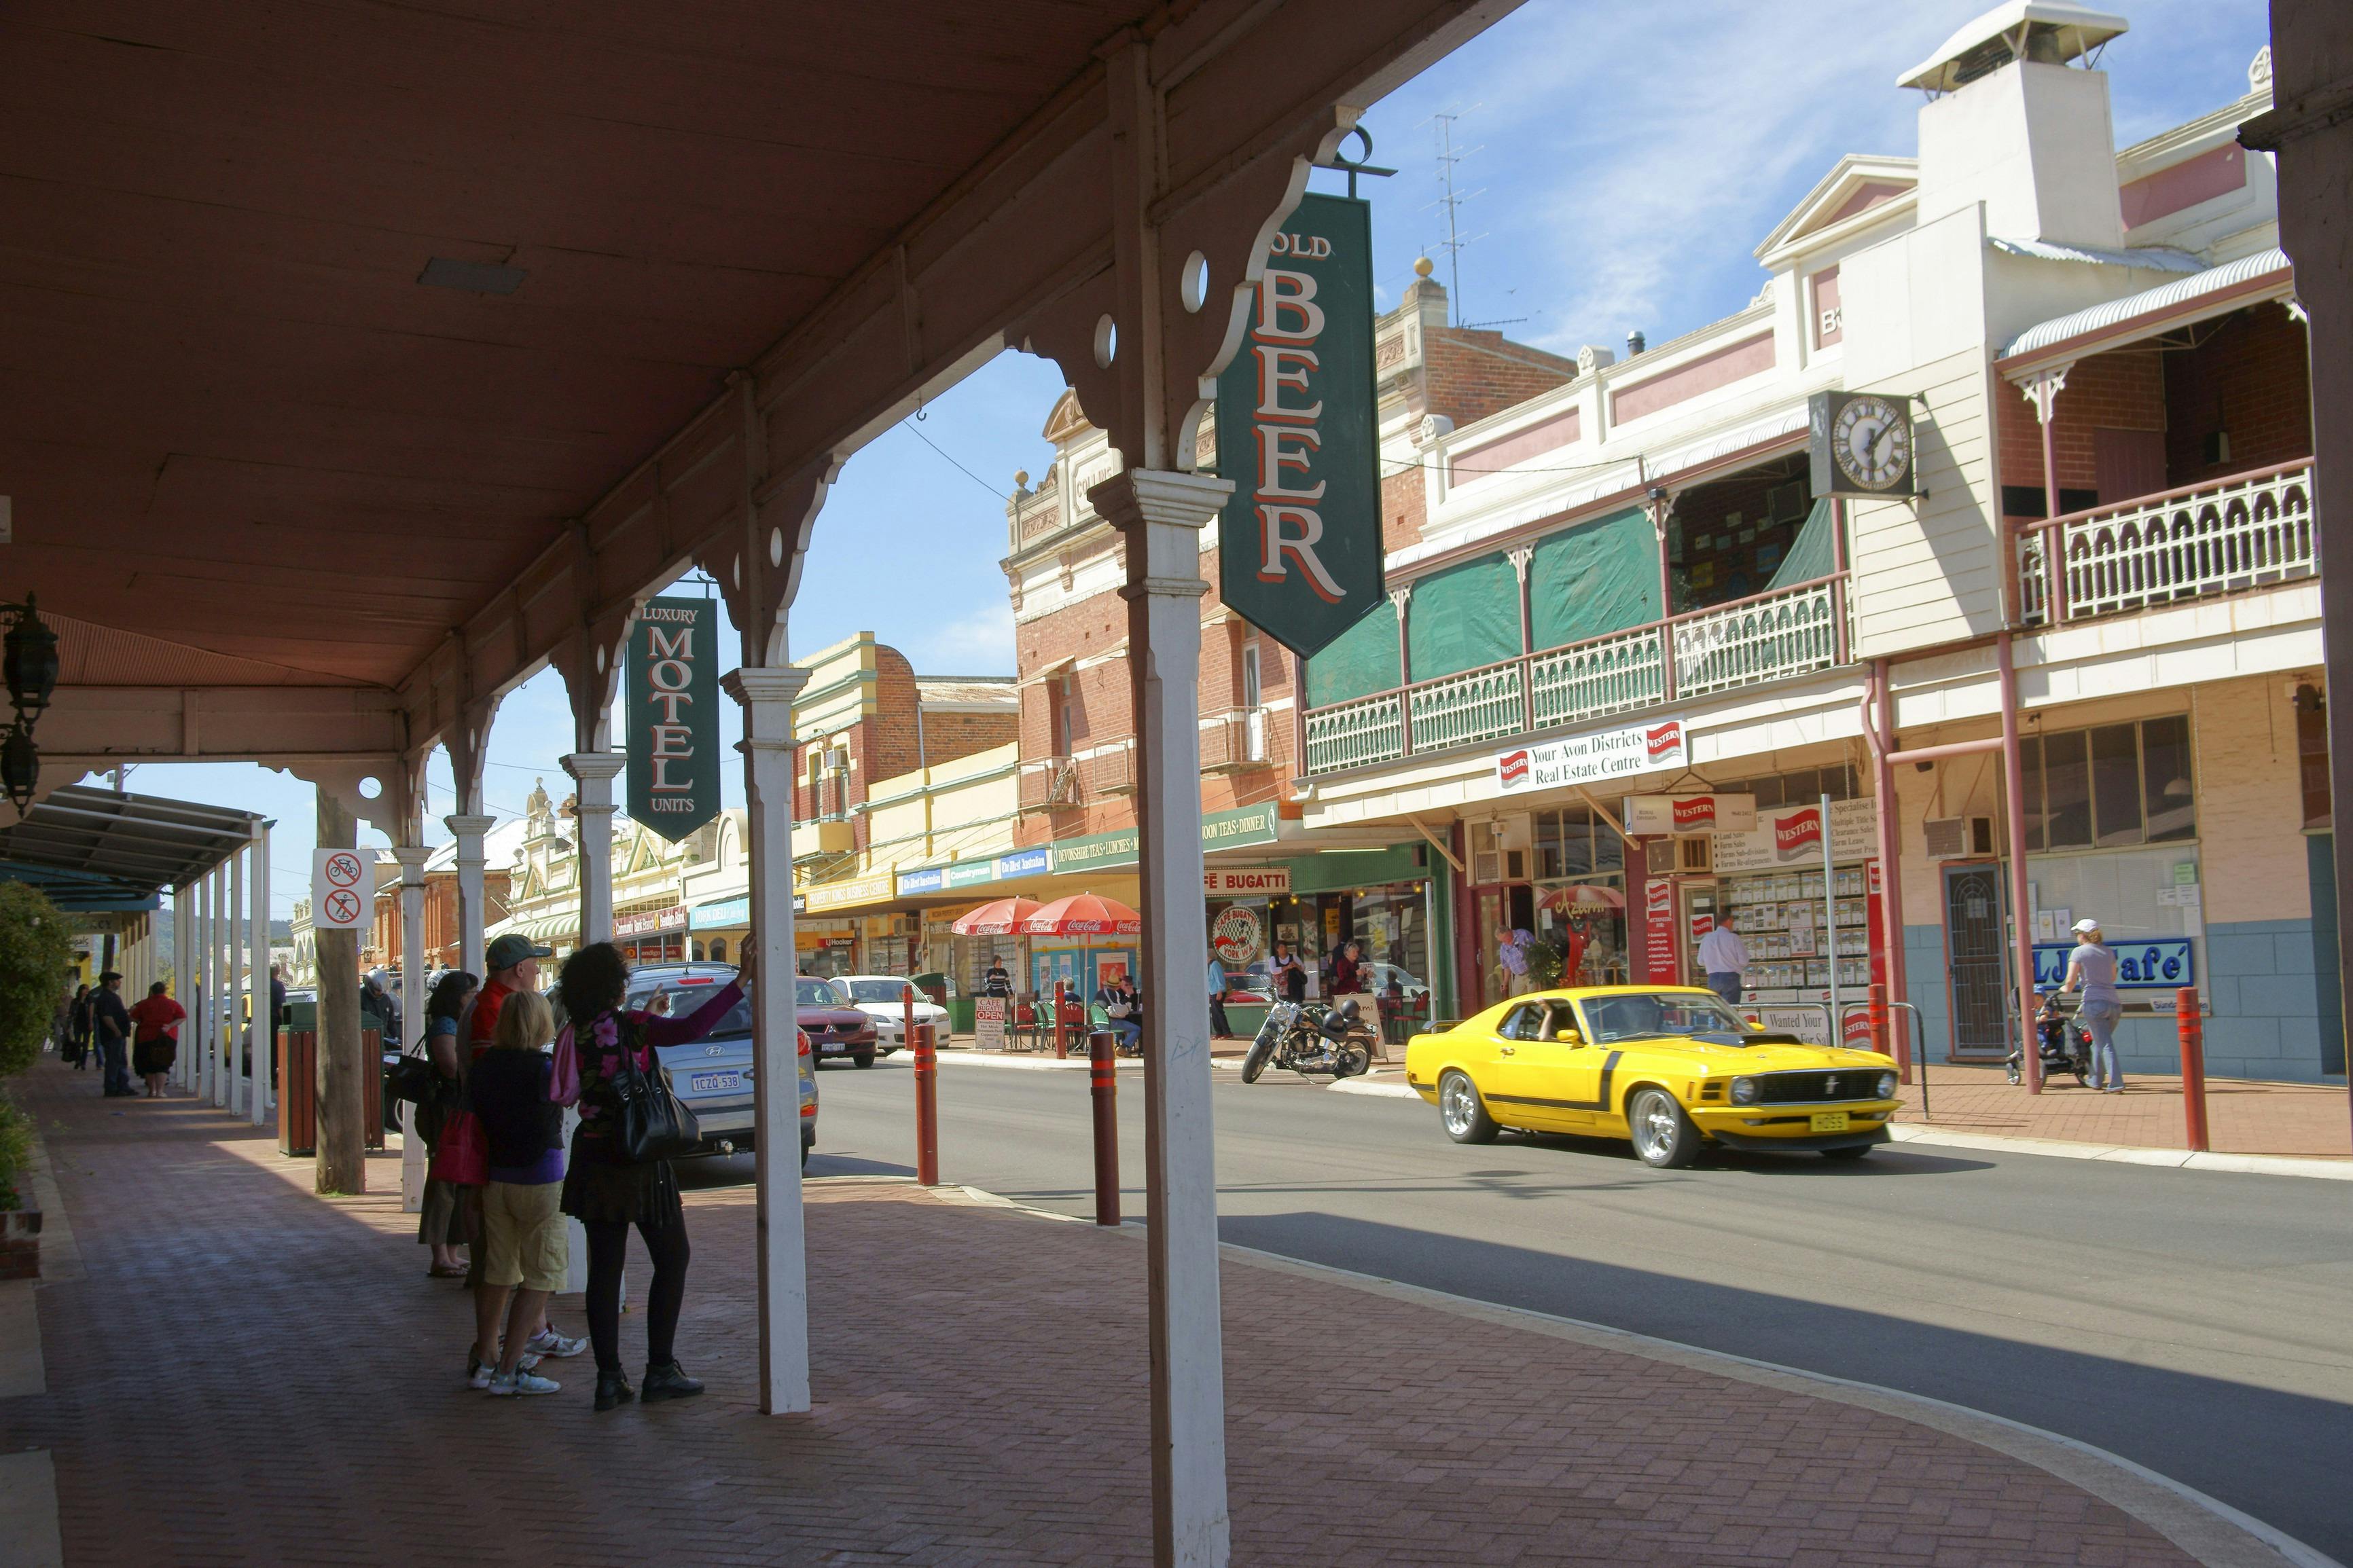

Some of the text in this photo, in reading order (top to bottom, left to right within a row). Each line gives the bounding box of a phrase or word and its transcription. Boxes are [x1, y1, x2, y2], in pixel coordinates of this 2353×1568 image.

[1269, 232, 1331, 260] OLD
[1252, 269, 1347, 602] BEER
[642, 608, 698, 623] LUXURY
[648, 626, 695, 792] MOTEL
[1532, 731, 1642, 763] Your Avon Districts
[1648, 730, 1679, 748] WESTERN
[1501, 758, 1527, 774] WESTERN
[1535, 767, 1558, 784] Real
[1564, 763, 1597, 780] Estate
[1601, 756, 1641, 773] Centre
[651, 798, 694, 812] UNITS
[1674, 804, 1714, 818] WESTERN
[1218, 820, 1236, 837] TEAS
[1239, 815, 1265, 833] DINNER
[1777, 820, 1819, 841] WESTERN
[1058, 845, 1089, 862] DEVONSHIRE
[1090, 843, 1103, 857] TEAS
[1105, 838, 1130, 855] LUNCHES
[1022, 856, 1045, 870] Australian
[920, 874, 940, 886] Australian
[951, 867, 990, 880] Countryman
[1226, 875, 1286, 888] BUGATTI
[810, 880, 888, 905] PROPERTY KINGS BUSINESS CENTRE
[793, 897, 805, 909] ooker
[616, 921, 633, 935] Community
[643, 916, 654, 930] Branch
[660, 911, 685, 928] Bendigo Bank
[1232, 911, 1257, 927] BUGATTI
[1224, 948, 1240, 959] YORK
[2120, 945, 2186, 981] afé
[978, 1011, 1003, 1019] OPEN
[1769, 1014, 1822, 1027] Wanted Your
[1844, 1021, 1869, 1034] ESTERN
[1801, 1033, 1829, 1046] For Sal
